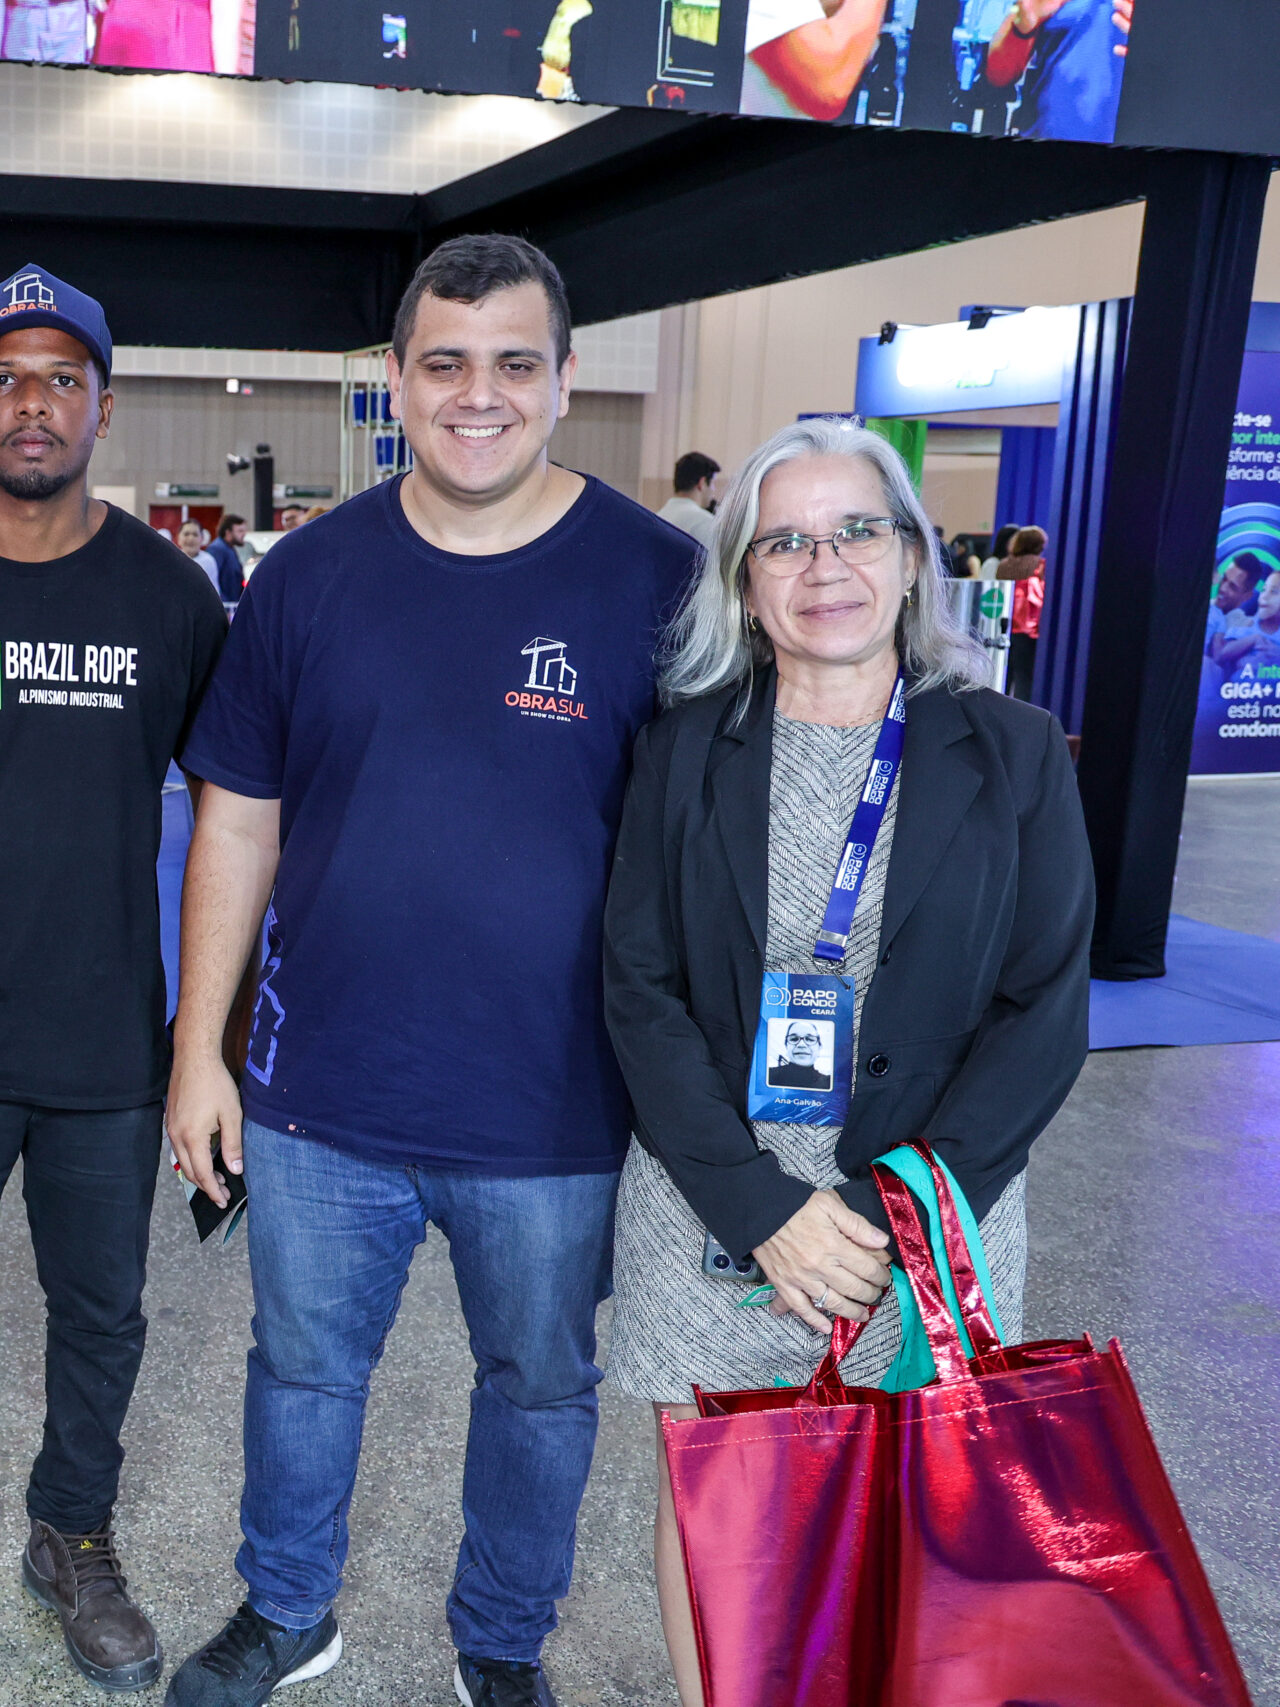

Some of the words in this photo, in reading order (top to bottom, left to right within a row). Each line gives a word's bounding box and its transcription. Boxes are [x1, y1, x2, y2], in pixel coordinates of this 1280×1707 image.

[5, 641, 79, 682] BRAZIL
[84, 645, 138, 686] ROPE
[1240, 663, 1254, 679] A
[18, 689, 68, 706] ALPINISMO
[69, 691, 124, 709] INDUSTRIAL
[1220, 682, 1273, 699] GIGA+
[505, 691, 588, 719] OBRASUL
[1227, 701, 1261, 718] está
[868, 775, 881, 804] CONDO
[874, 776, 889, 805] PAPO
[841, 858, 855, 890] CONDO
[847, 859, 863, 891] PAPO
[793, 989, 837, 1000] PAPO
[793, 998, 837, 1008] CONDO
[811, 1007, 836, 1015] CEARÁ
[774, 1097, 789, 1105] Ana
